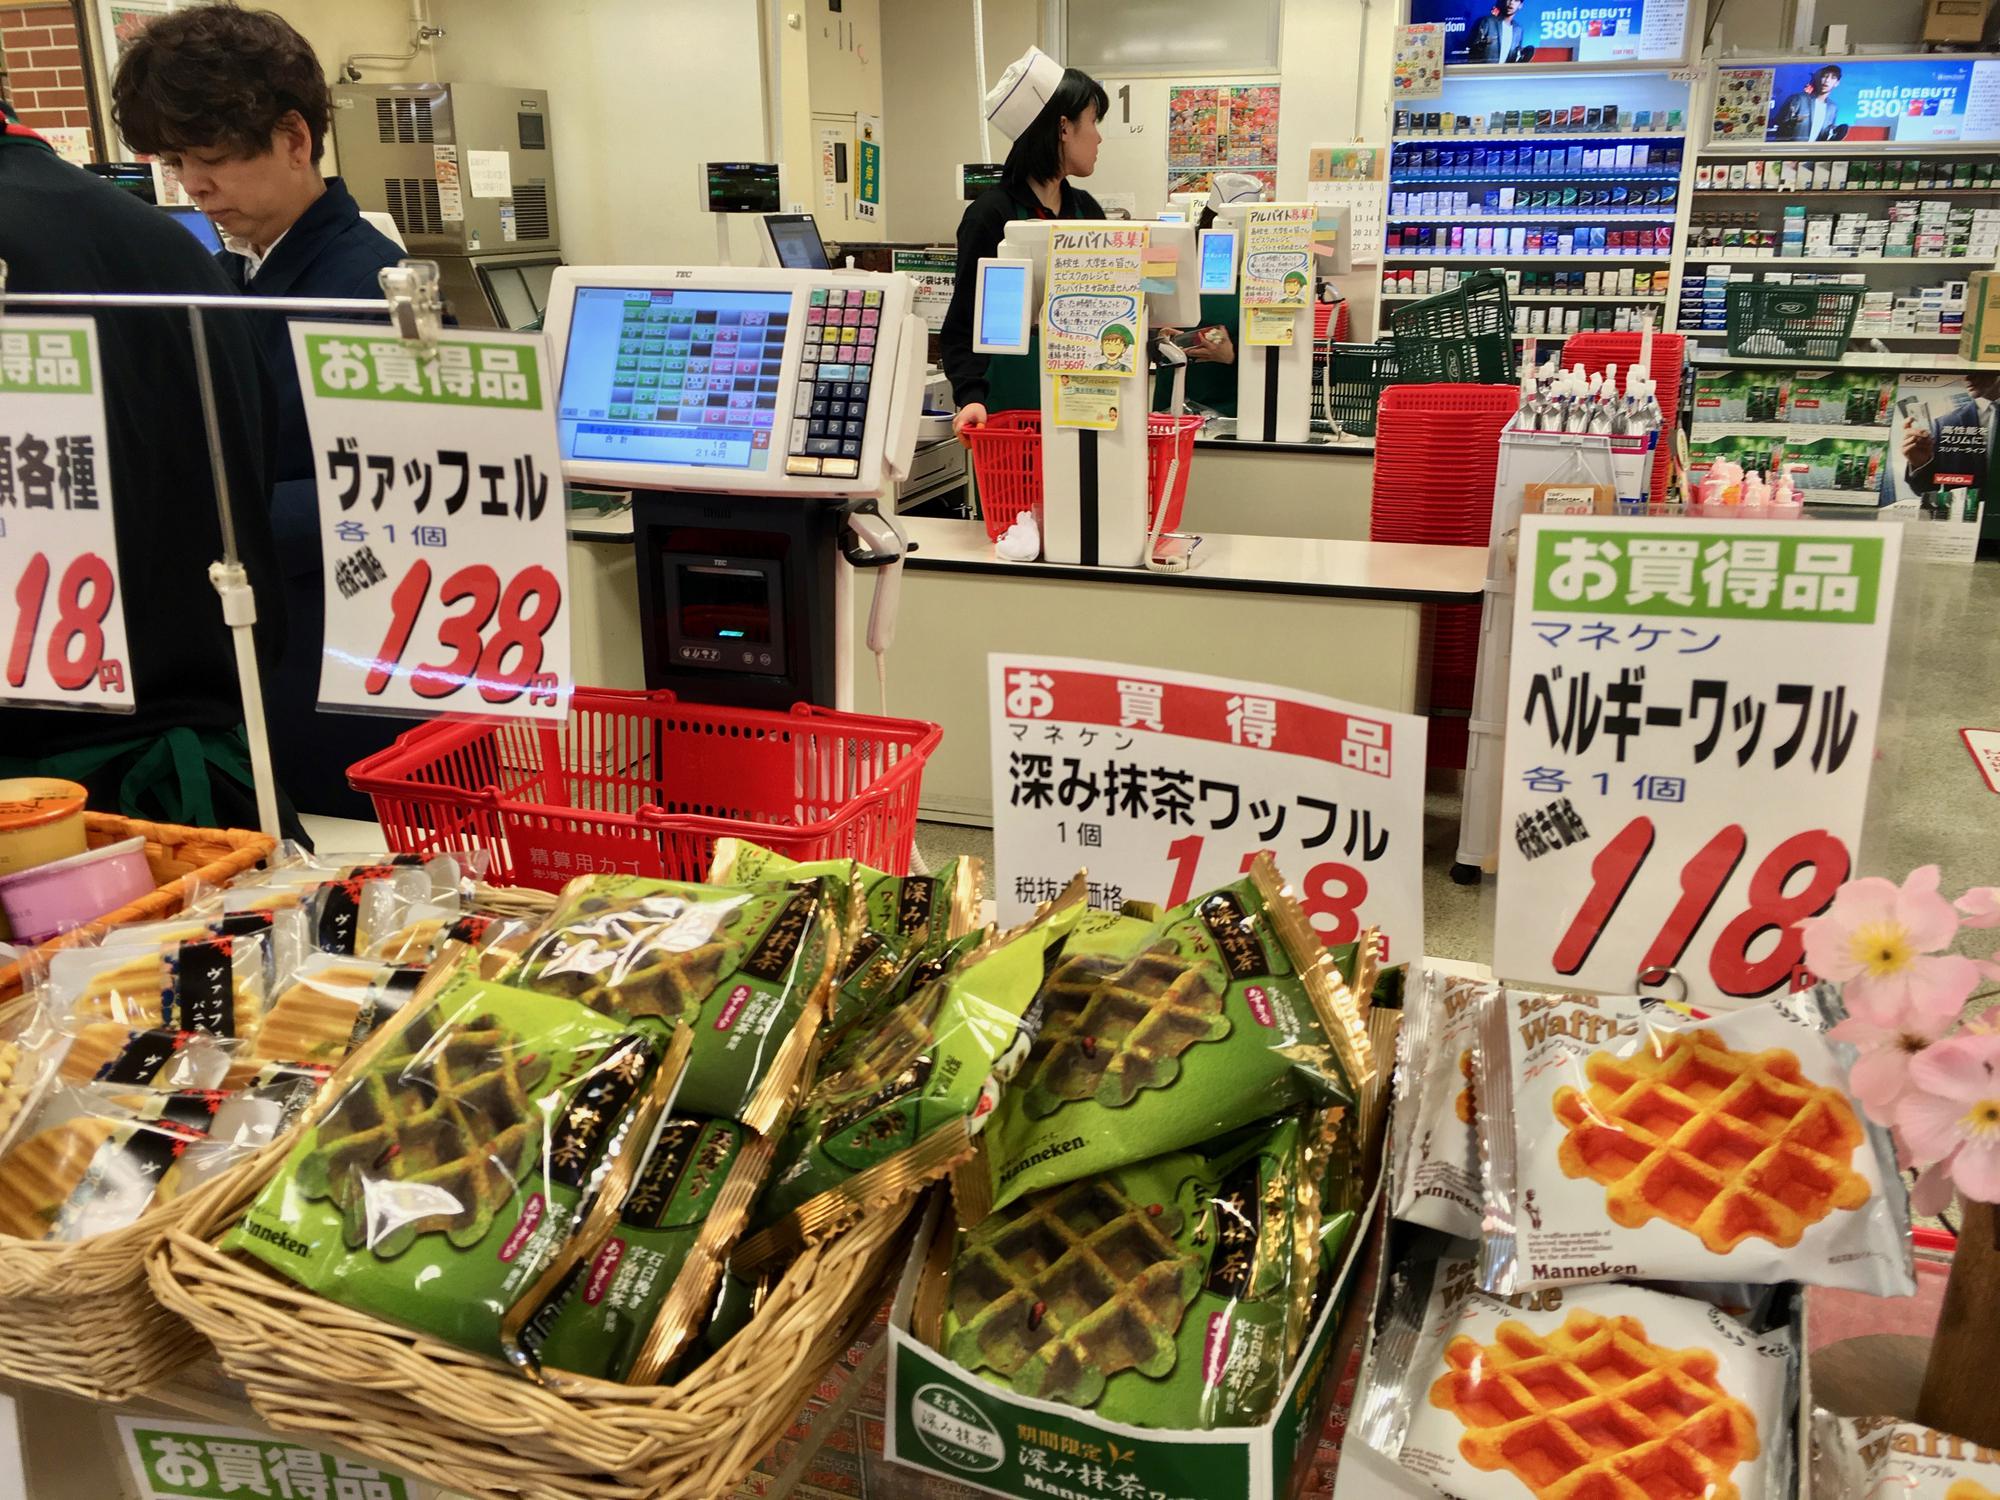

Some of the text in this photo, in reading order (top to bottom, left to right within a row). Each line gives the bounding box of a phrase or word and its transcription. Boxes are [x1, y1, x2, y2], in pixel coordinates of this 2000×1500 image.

[1540, 7, 1632, 20] mini DEBUT!
[1540, 21, 1581, 39] 380
[1118, 84, 1130, 124] 1
[1857, 86, 1957, 99] mini DEBUT!
[1856, 100, 1899, 118] 380
[318, 340, 529, 401] お買得品
[1904, 375, 1940, 383] KENT
[819, 386, 861, 395] 7 8 9
[815, 404, 858, 414] 4 5 6
[832, 423, 838, 432] 2
[849, 424, 856, 433] 3
[326, 437, 549, 521] ヴァッフェル
[1547, 536, 1860, 612] お買得品
[1531, 621, 1722, 654] マネケン
[1523, 665, 1859, 774] ベルギーワッフル
[1008, 723, 1135, 750] マネケン
[1009, 750, 1390, 862] 深み抹茶ワッフル
[1056, 822, 1103, 847] 1個
[1531, 1261, 1638, 1280] Manneken
[1017, 1424, 1103, 1462] 期間限定
